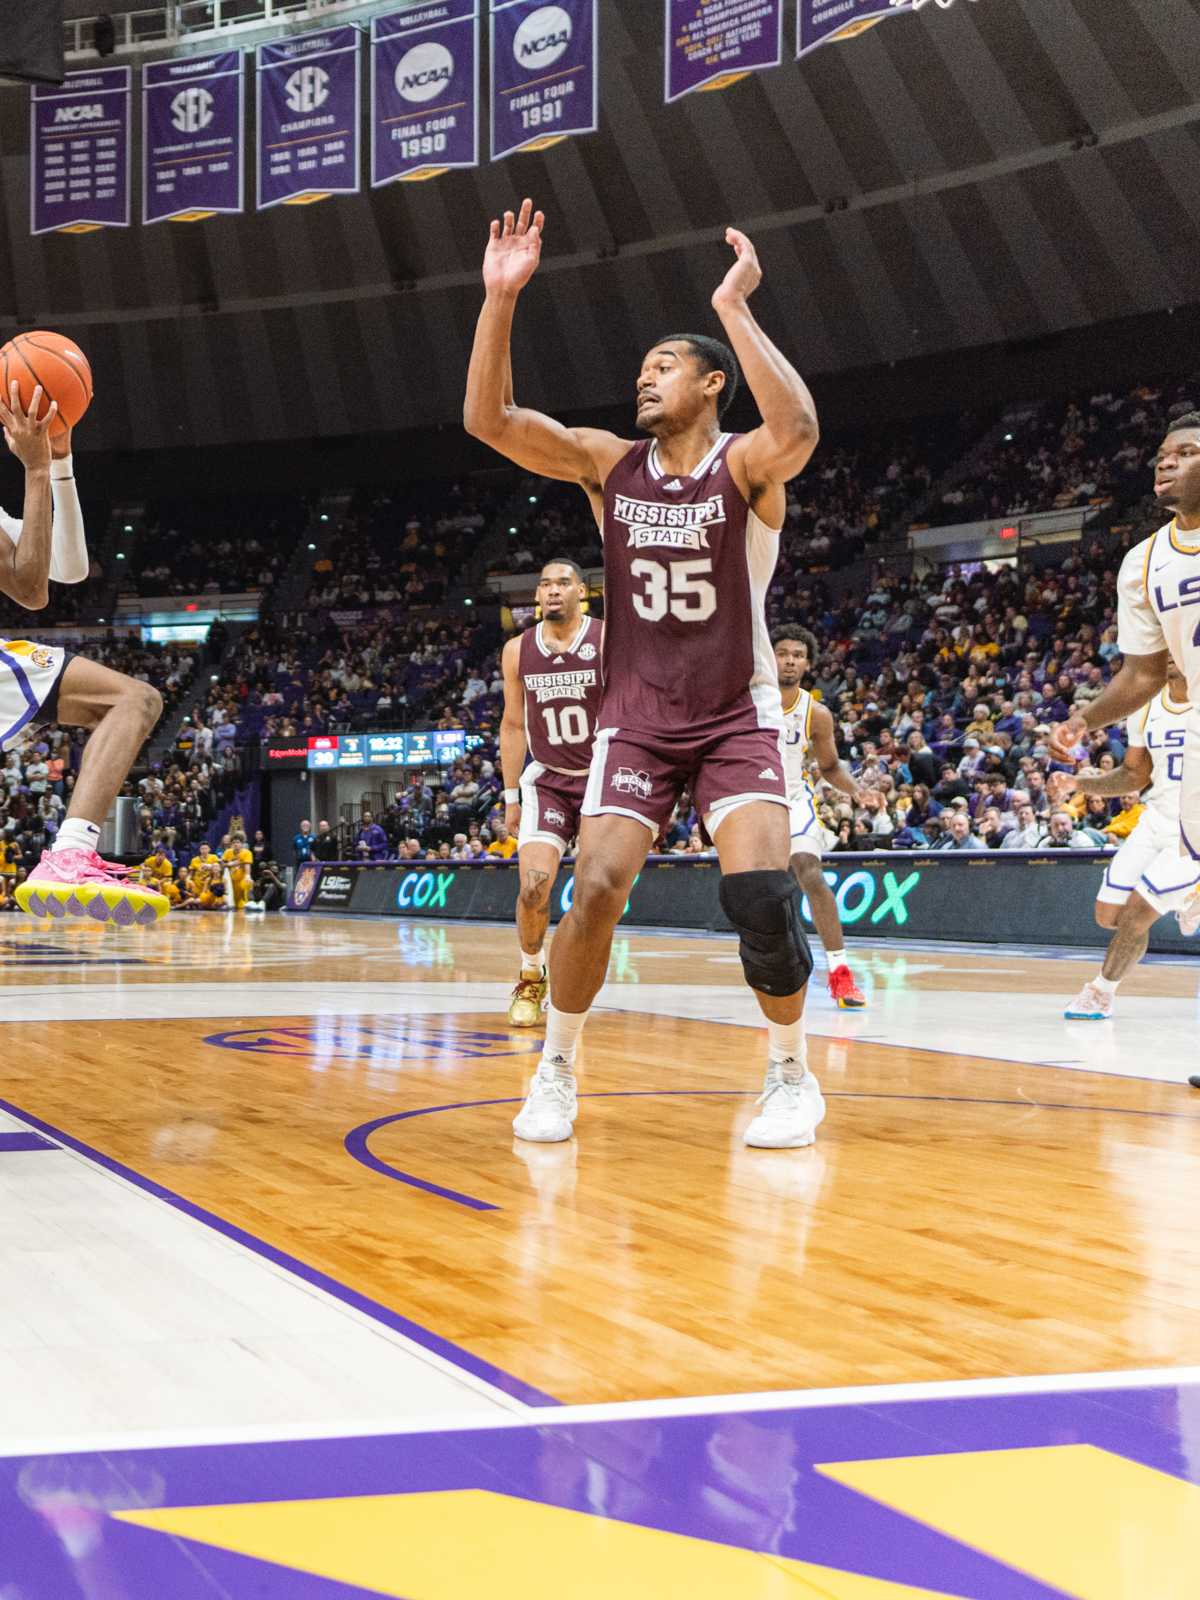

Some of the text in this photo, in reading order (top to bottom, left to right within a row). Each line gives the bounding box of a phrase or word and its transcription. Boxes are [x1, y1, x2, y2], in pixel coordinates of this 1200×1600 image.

[399, 6, 449, 26] VOLLEYBALL
[520, 29, 568, 58] NCAA
[285, 66, 330, 112] SEC
[401, 66, 448, 91] NCAA
[510, 80, 575, 111] FINAL FOUR
[54, 104, 104, 123] NCAA
[171, 87, 215, 133] SEC
[281, 114, 336, 133] CHAMPIONS
[522, 99, 562, 129] 1991
[391, 115, 456, 140] FINAL FOUR
[401, 133, 446, 159] 1990
[613, 498, 726, 527] MISSISSIPPI
[639, 530, 693, 546] STATE
[630, 558, 717, 623] 35
[524, 671, 596, 688] MISSISSIPPI
[544, 686, 576, 697] STATE
[542, 705, 589, 746] 10
[397, 872, 455, 908] COX
